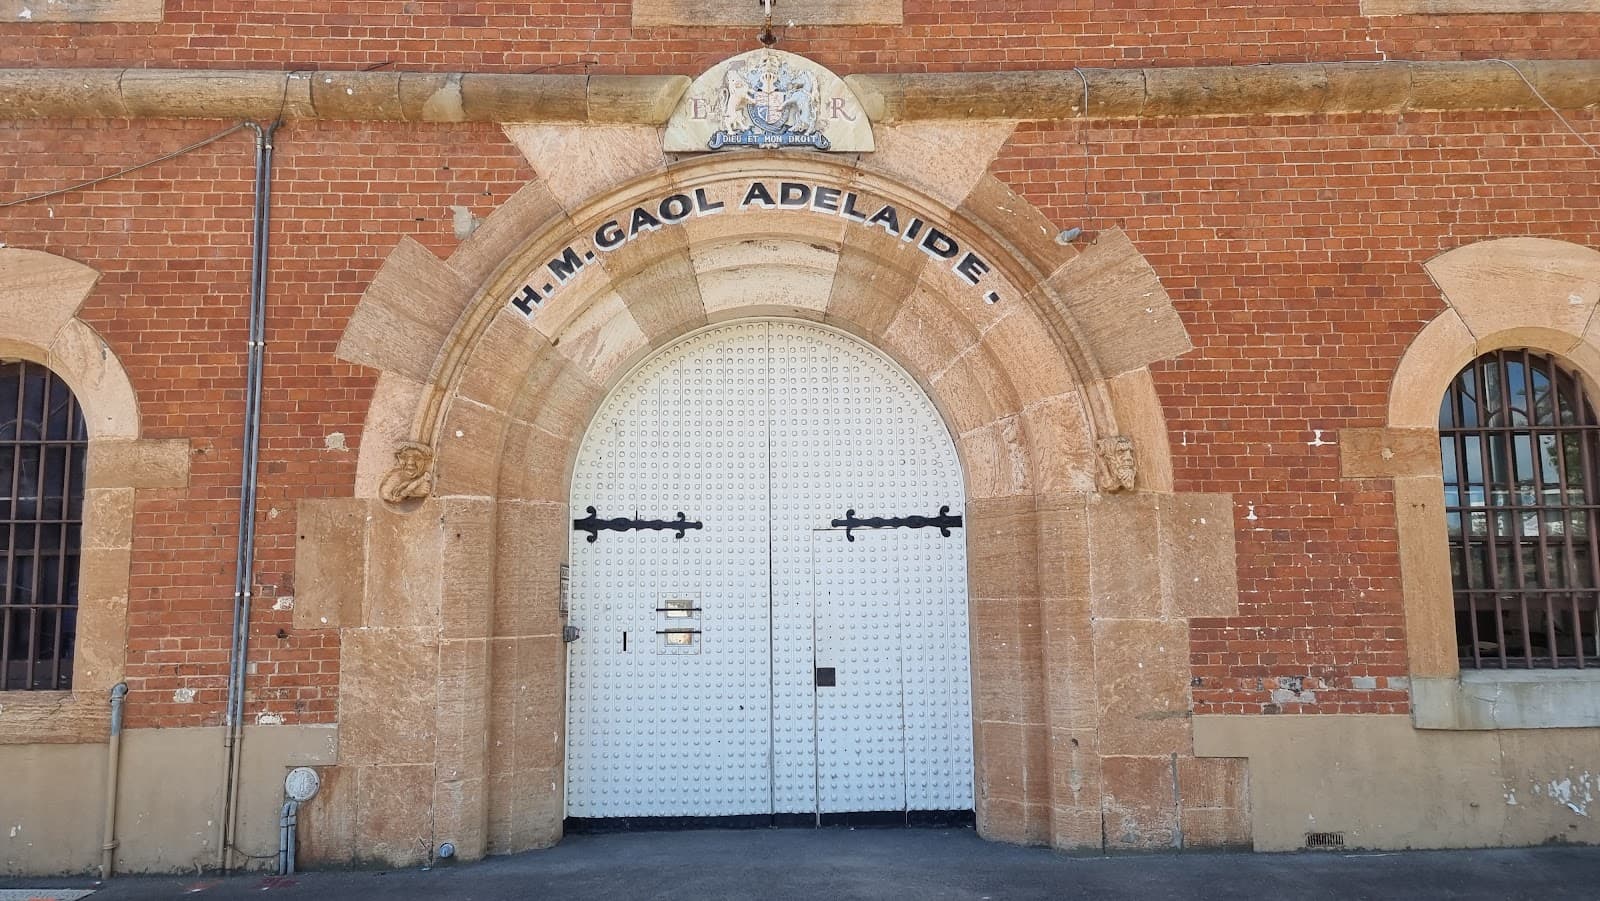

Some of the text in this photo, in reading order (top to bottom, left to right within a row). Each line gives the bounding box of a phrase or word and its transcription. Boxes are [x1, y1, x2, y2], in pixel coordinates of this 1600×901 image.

[691, 98, 856, 121] E R
[722, 134, 742, 143] DIEU
[748, 134, 759, 143] ET
[788, 134, 816, 143] DROIT
[593, 188, 725, 252] GAOL
